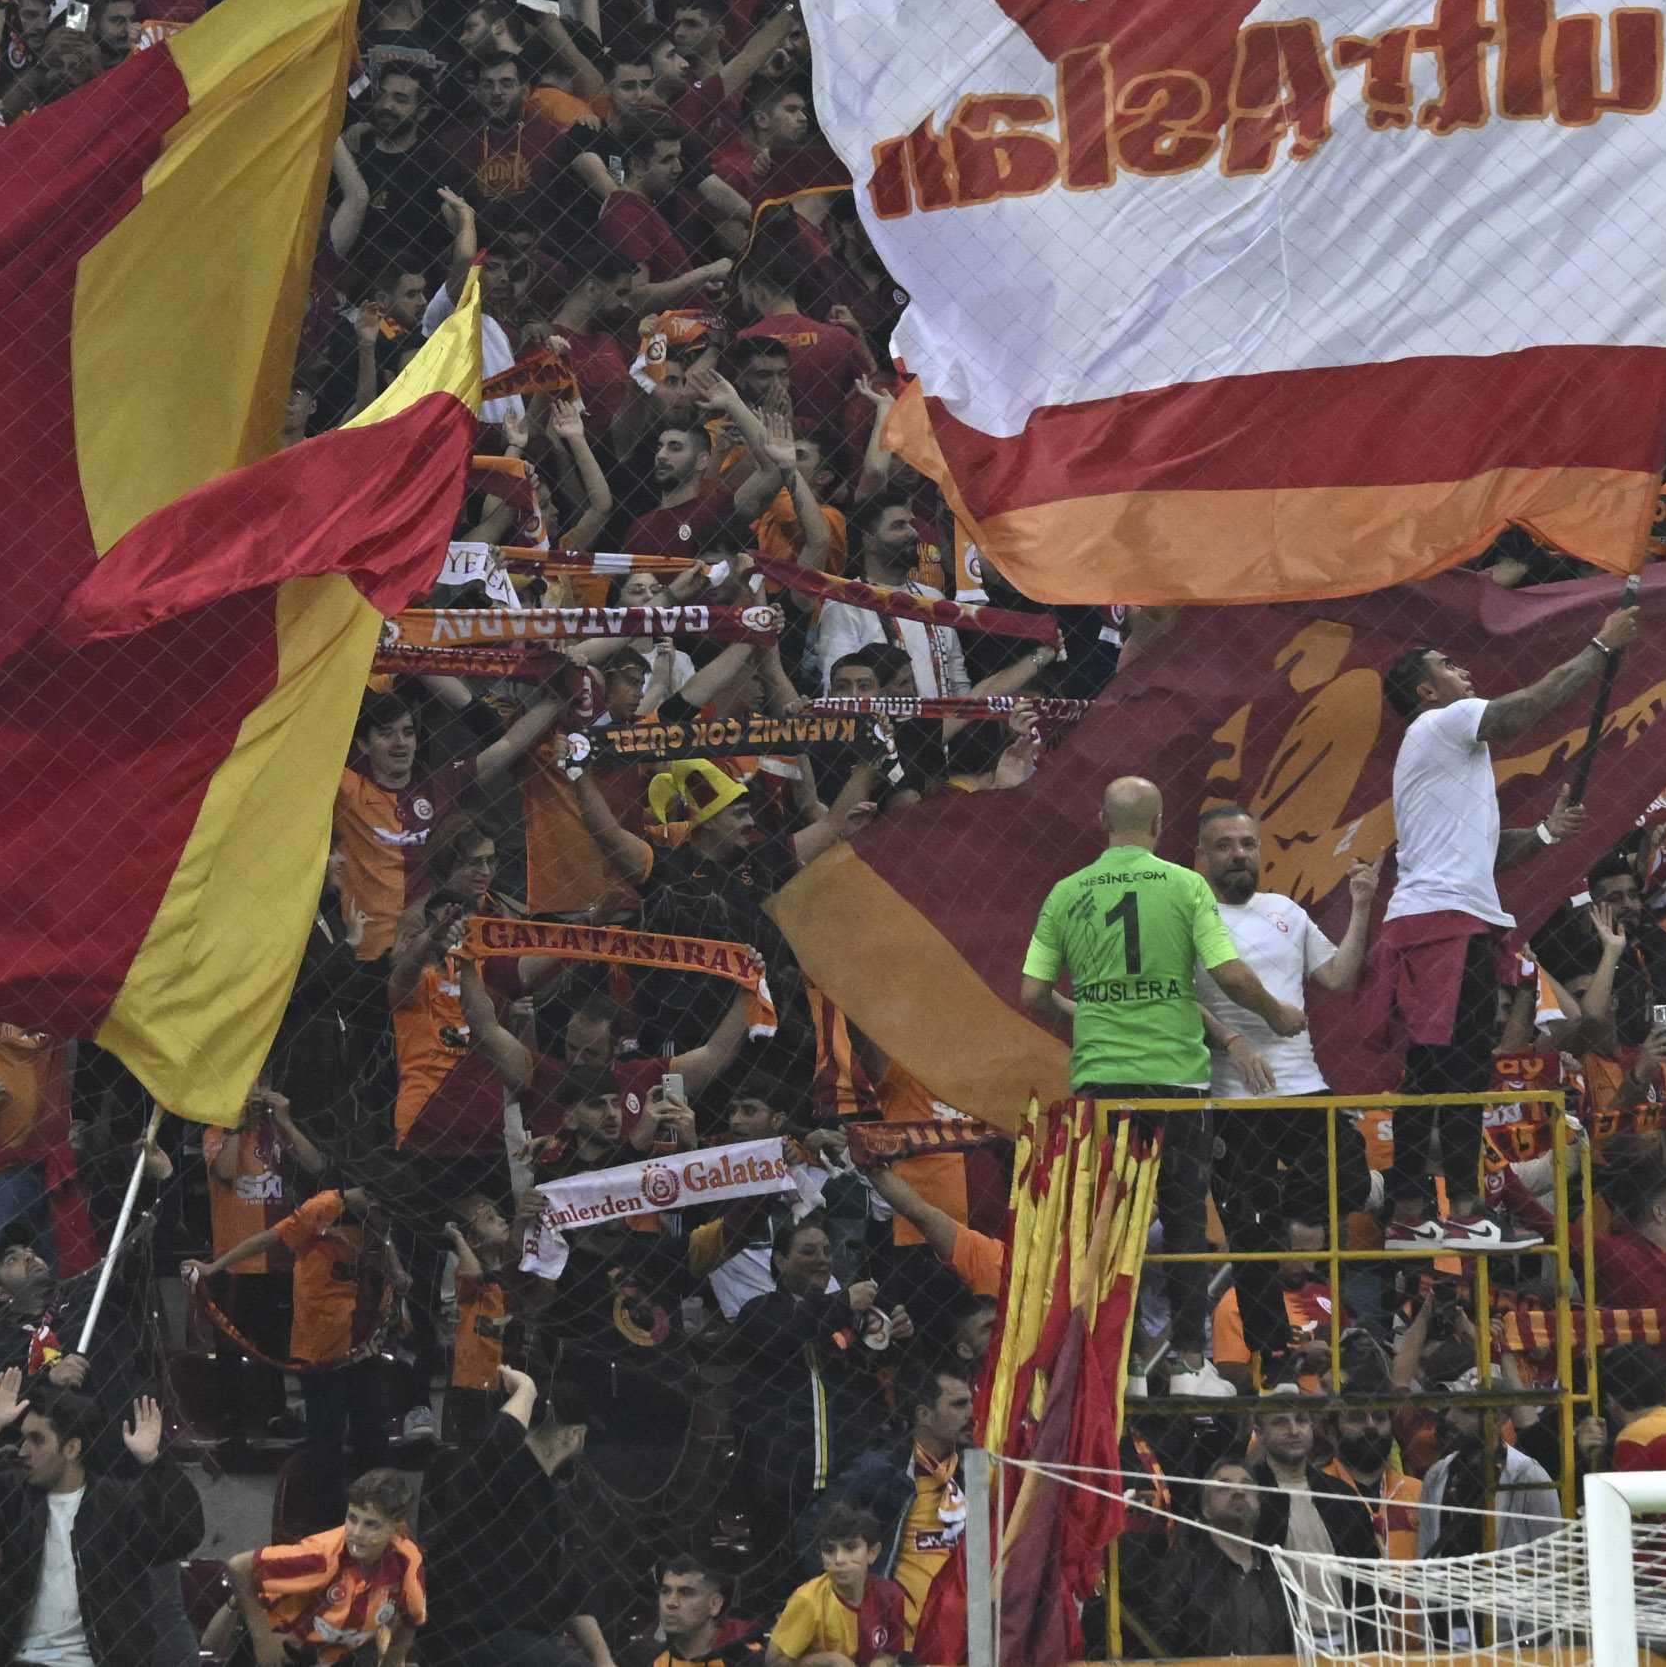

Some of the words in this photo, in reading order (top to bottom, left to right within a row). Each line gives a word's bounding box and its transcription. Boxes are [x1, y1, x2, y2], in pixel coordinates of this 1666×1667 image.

[607, 724, 684, 755] GÜZEL
[693, 711, 742, 745] ÇOK
[748, 716, 856, 743] KAFAMIZ
[1105, 891, 1142, 975] 1
[482, 922, 755, 979] GALATASARAY
